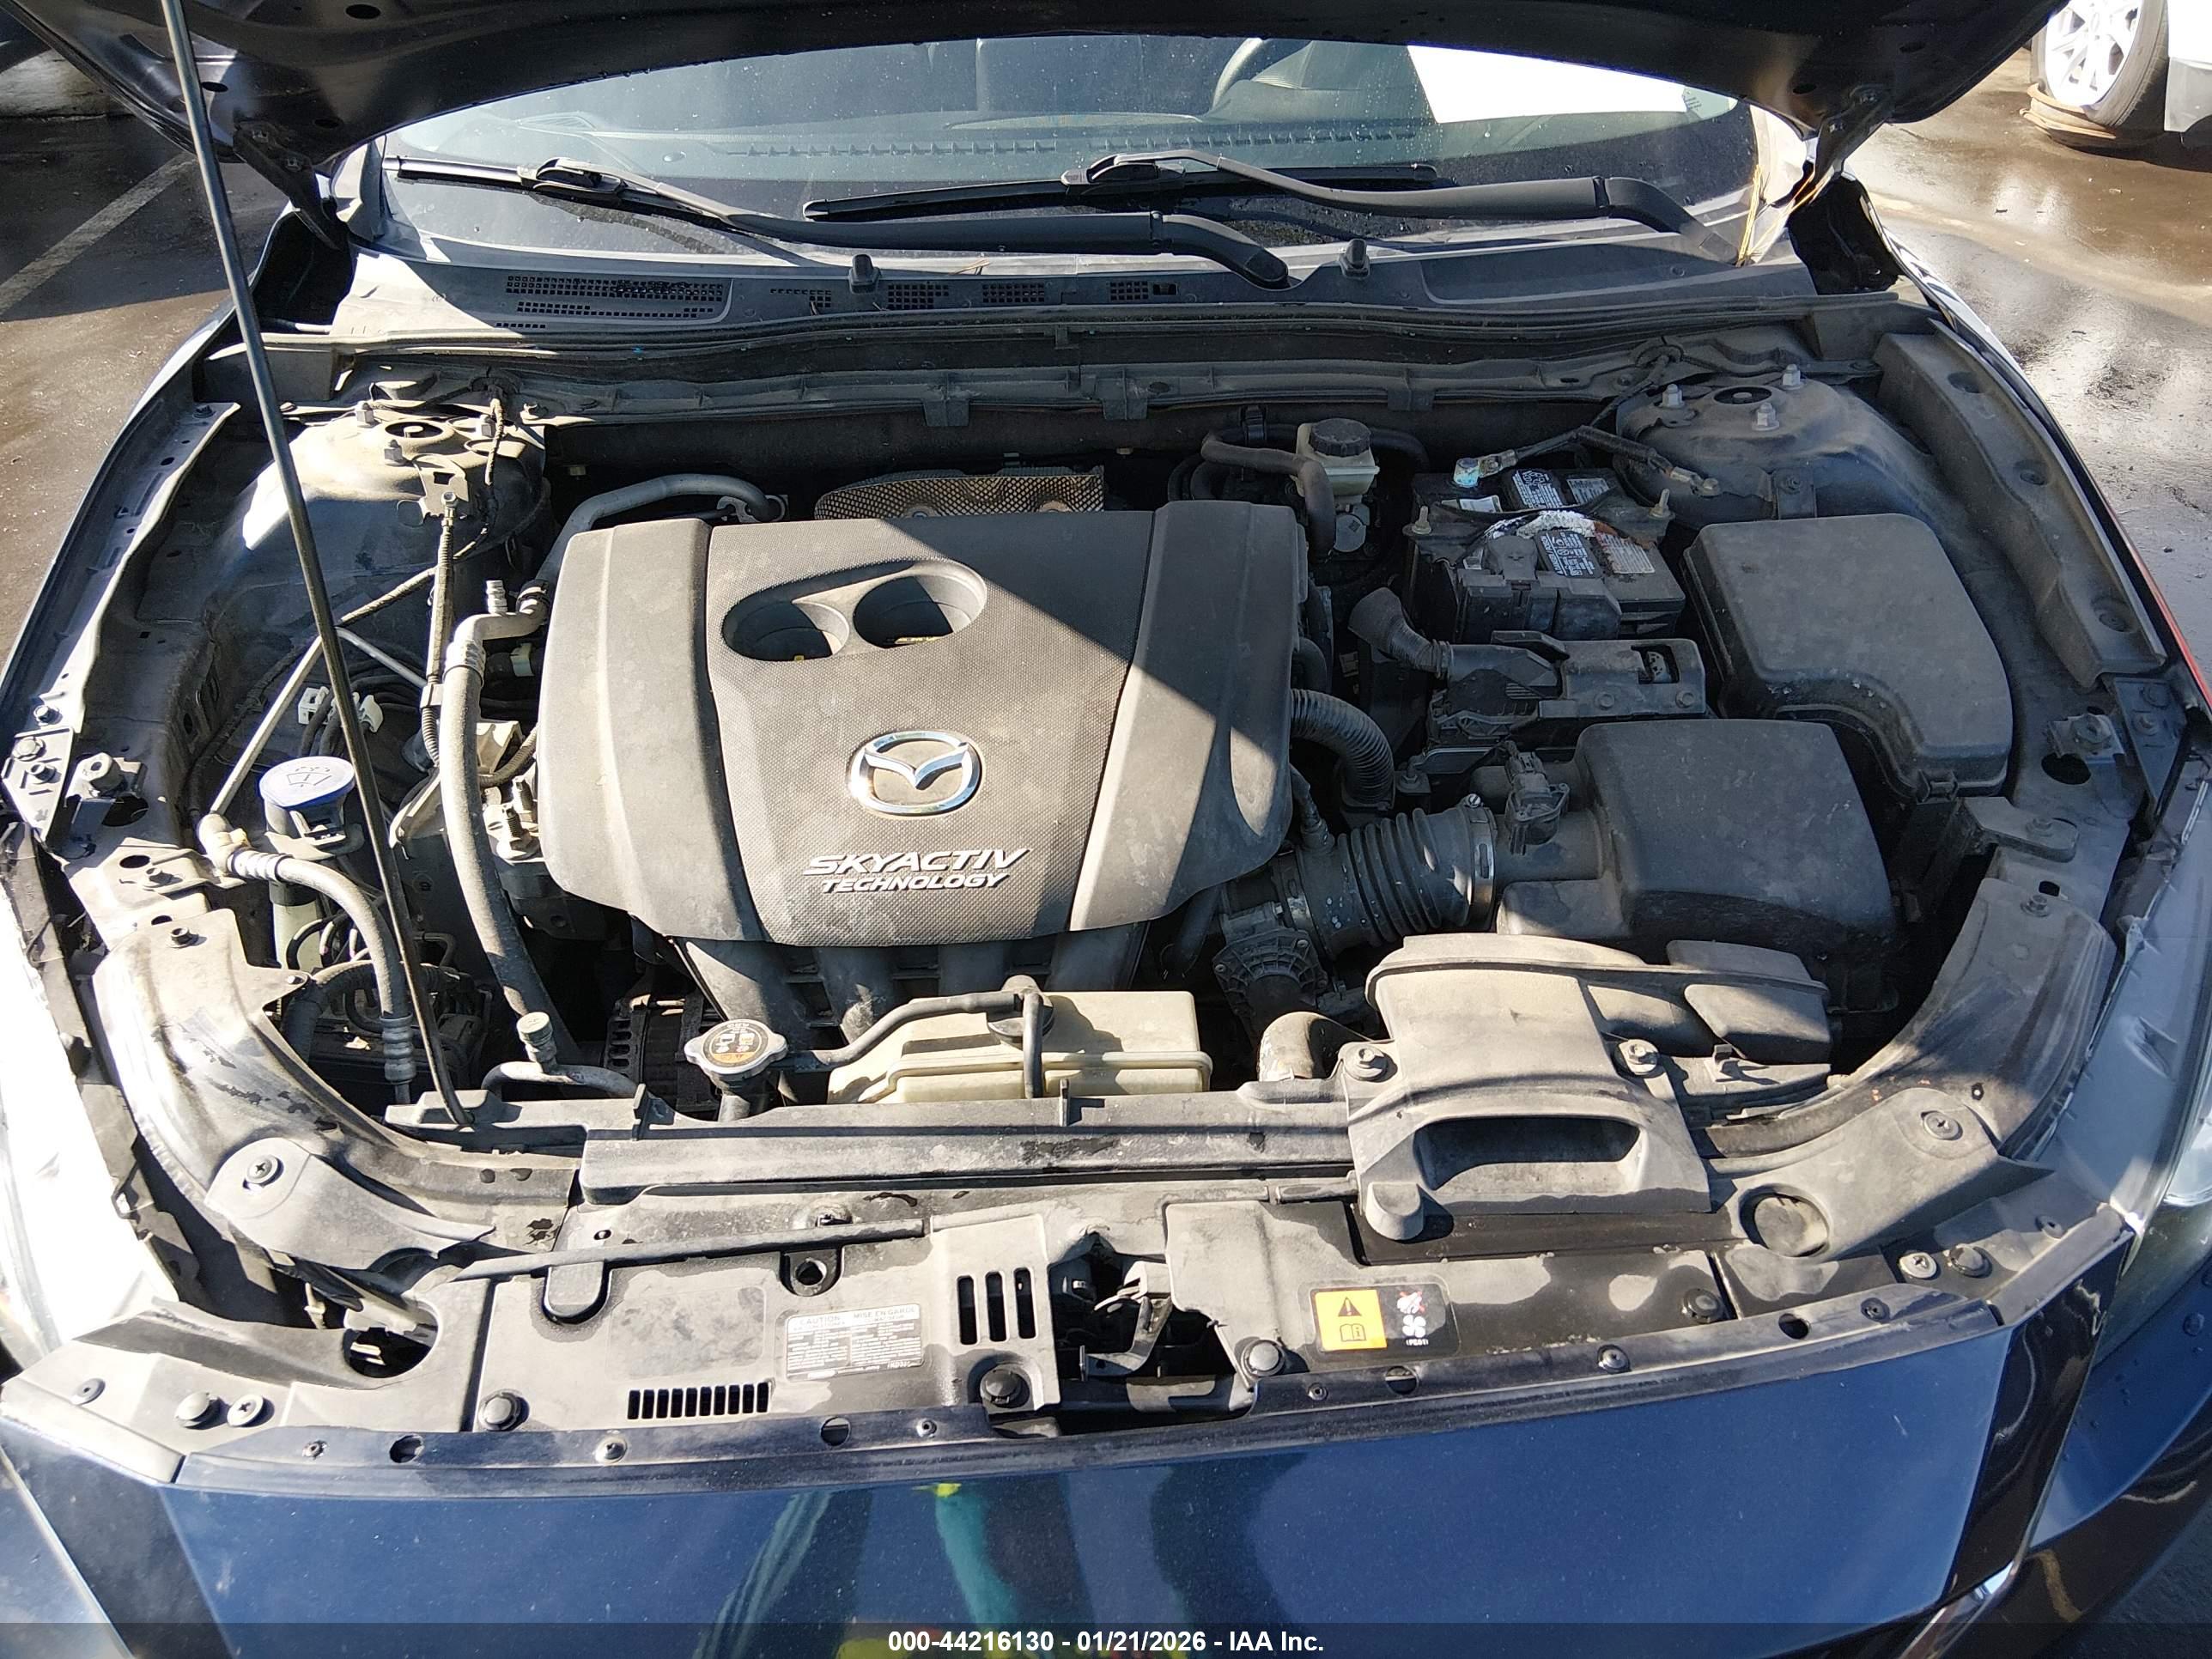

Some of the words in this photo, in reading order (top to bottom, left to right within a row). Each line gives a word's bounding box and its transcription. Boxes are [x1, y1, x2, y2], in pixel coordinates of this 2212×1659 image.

[804, 848, 1030, 875] SKYACTIV
[822, 872, 1010, 893] TECHNOLOGY
[799, 1316, 841, 1326] CAUTION
